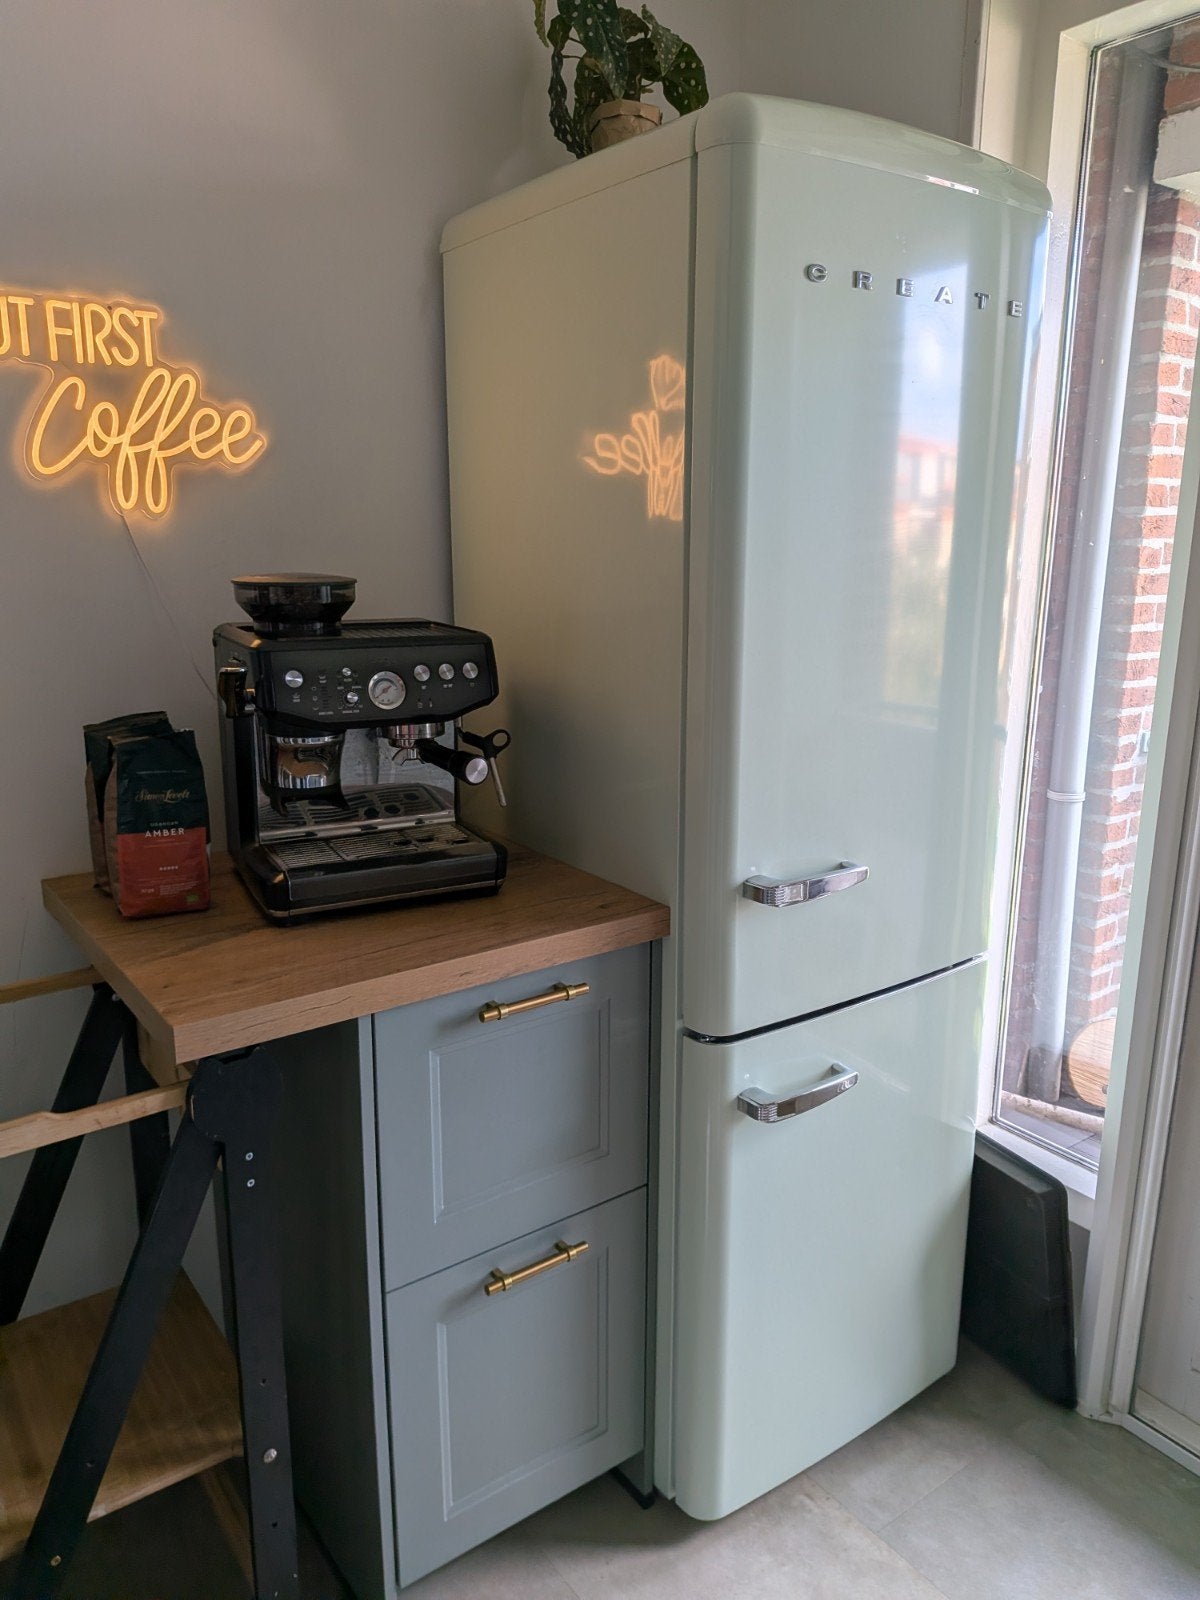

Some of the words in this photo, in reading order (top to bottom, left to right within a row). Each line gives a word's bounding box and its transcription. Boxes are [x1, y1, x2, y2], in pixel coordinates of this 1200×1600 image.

[46, 300, 158, 367] FIRST
[32, 368, 262, 513] Coffee
[145, 828, 185, 838] AMBER
